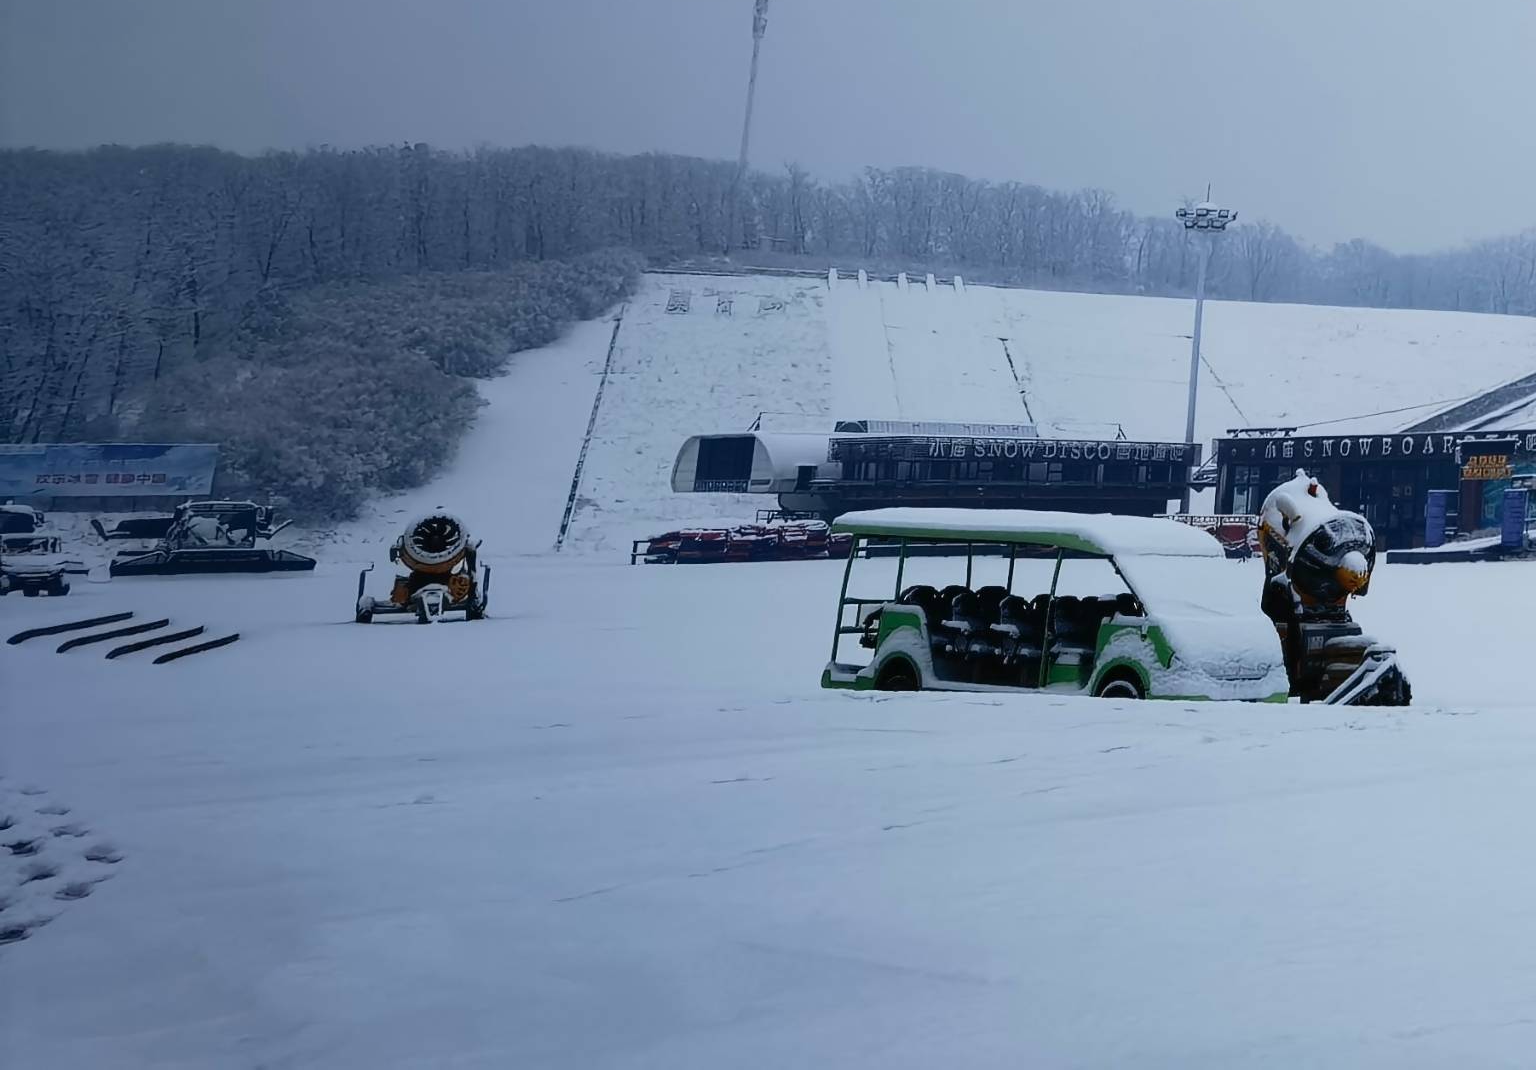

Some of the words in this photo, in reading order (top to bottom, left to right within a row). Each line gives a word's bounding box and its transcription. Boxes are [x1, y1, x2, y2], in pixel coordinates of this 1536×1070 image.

[973, 439, 1037, 459] SNOW
[1042, 440, 1112, 460] DISCO
[1303, 435, 1475, 458] SNOWBOAR
